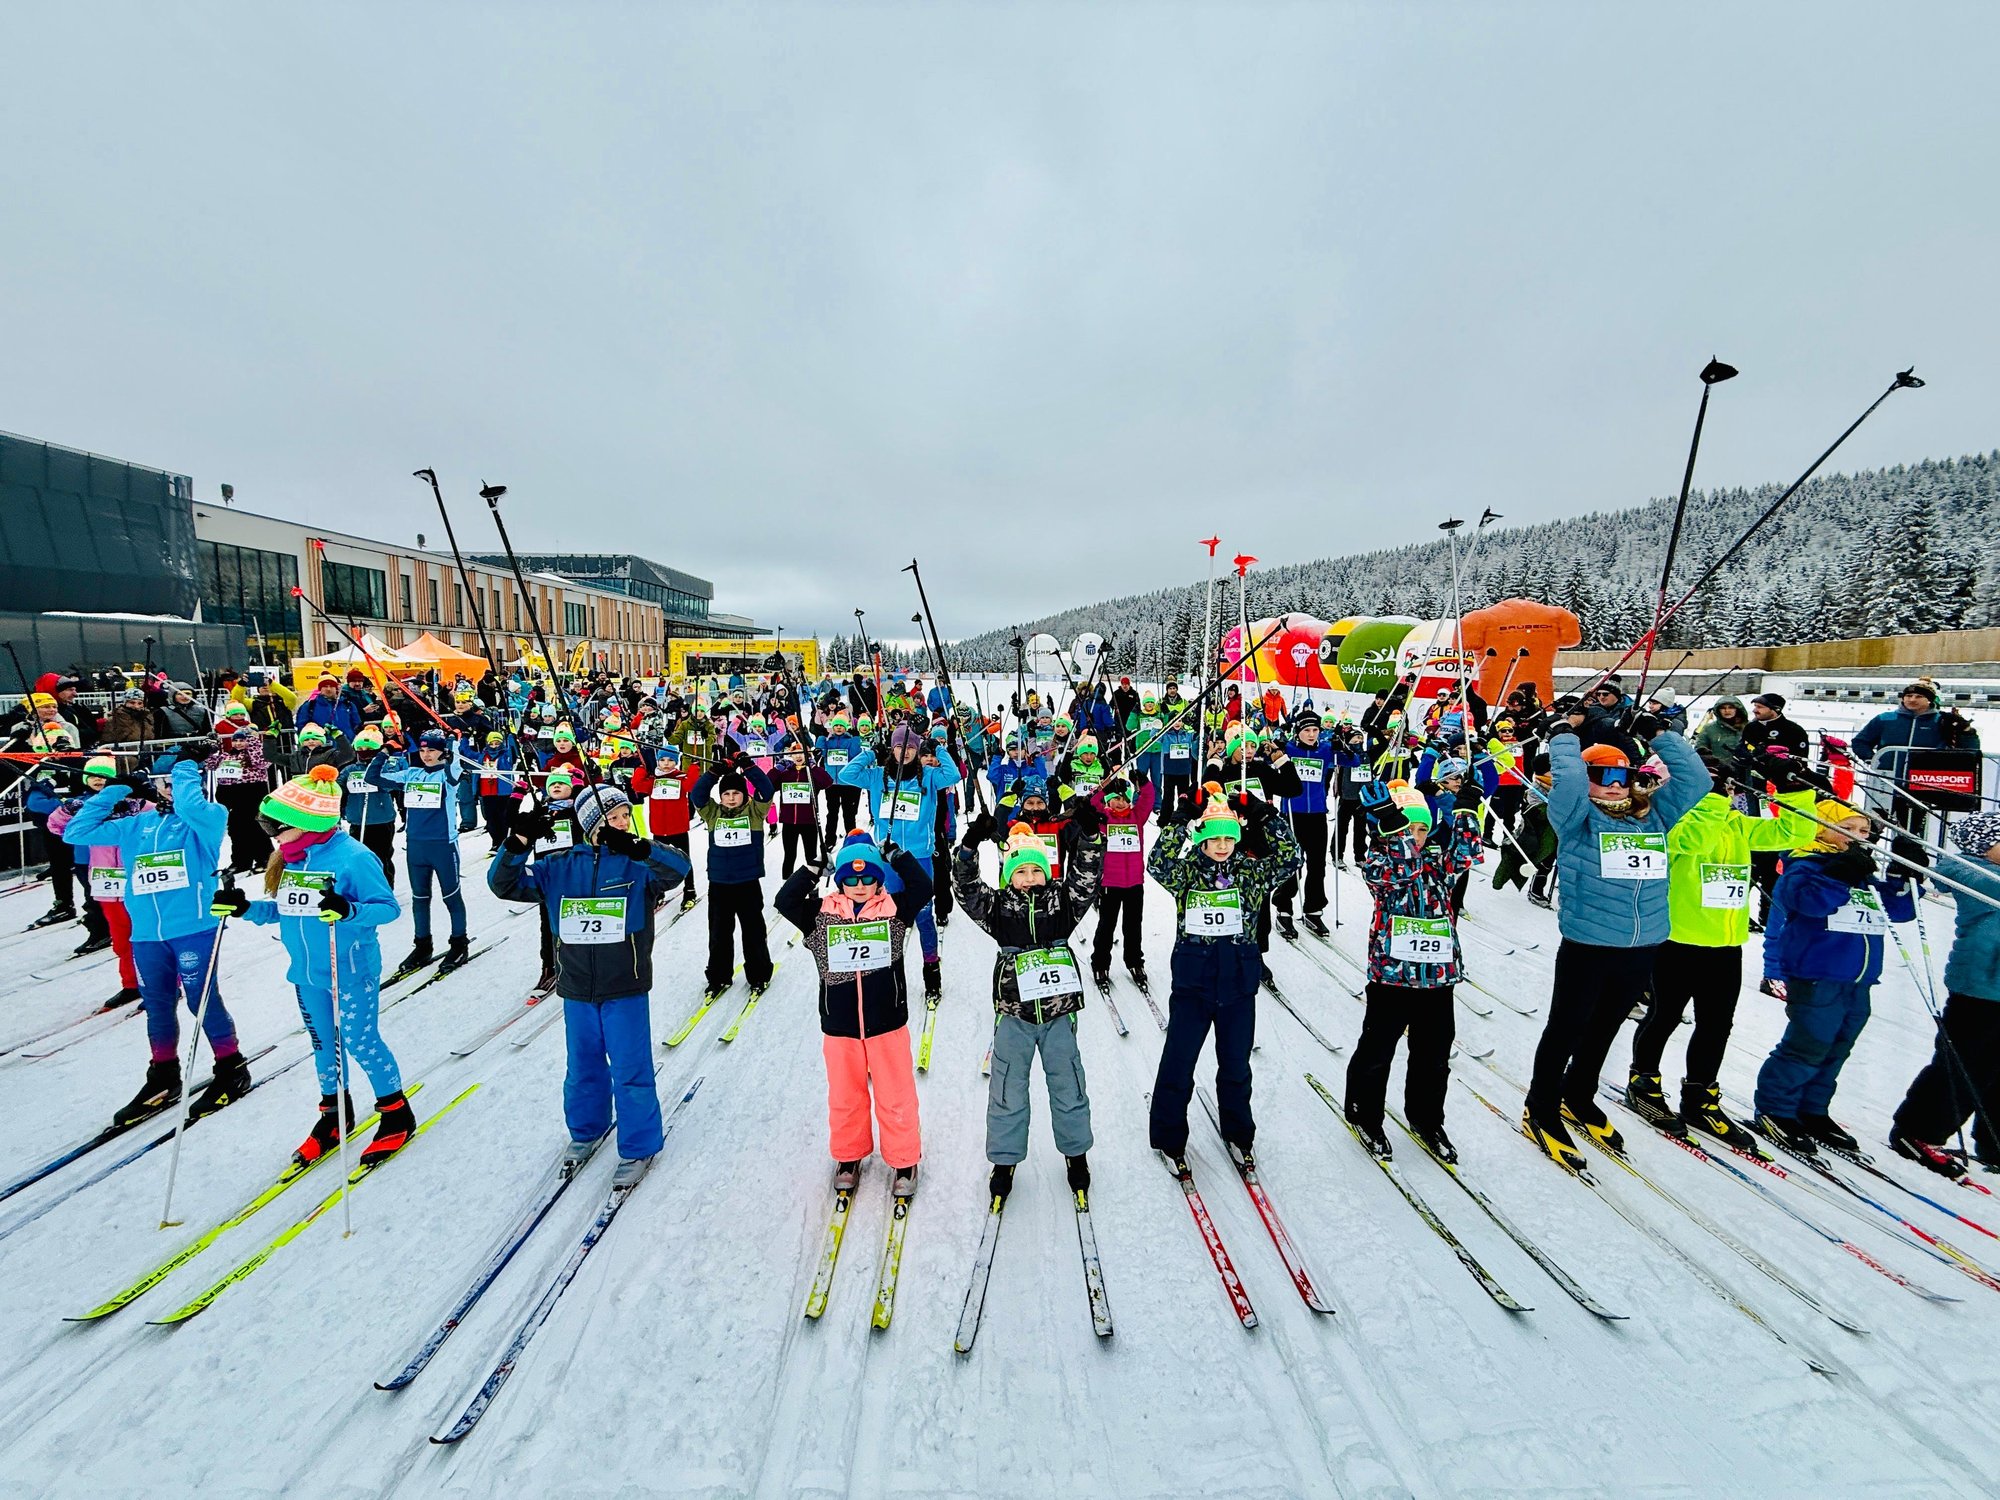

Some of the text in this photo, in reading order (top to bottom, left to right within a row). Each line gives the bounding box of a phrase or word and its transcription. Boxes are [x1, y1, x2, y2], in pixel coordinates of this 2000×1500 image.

[1340, 663, 1389, 678] Szklarska
[1298, 768, 1316, 776] 114
[1910, 774, 1972, 784] DATASPORT
[661, 787, 668, 795] 6
[788, 791, 804, 799] 124
[416, 794, 424, 802] 7
[724, 831, 739, 840] 41
[1119, 837, 1133, 846] 16
[1627, 855, 1651, 868] 31
[138, 870, 169, 885] 105
[104, 881, 120, 890] 21
[1726, 886, 1744, 898] 76
[288, 892, 309, 905] 60
[1203, 912, 1225, 925] 50
[580, 920, 602, 933] 73
[1409, 939, 1441, 952] 129
[848, 945, 870, 960] 72
[1039, 970, 1061, 985] 45
[1663, 1130, 1709, 1163] SPORTEN
[1762, 1133, 1813, 1167] SALOMON
[1808, 1136, 1857, 1164] ALOMON
[1731, 1145, 1788, 1180] SPORTEN
[122, 1242, 202, 1301] FISCHER
